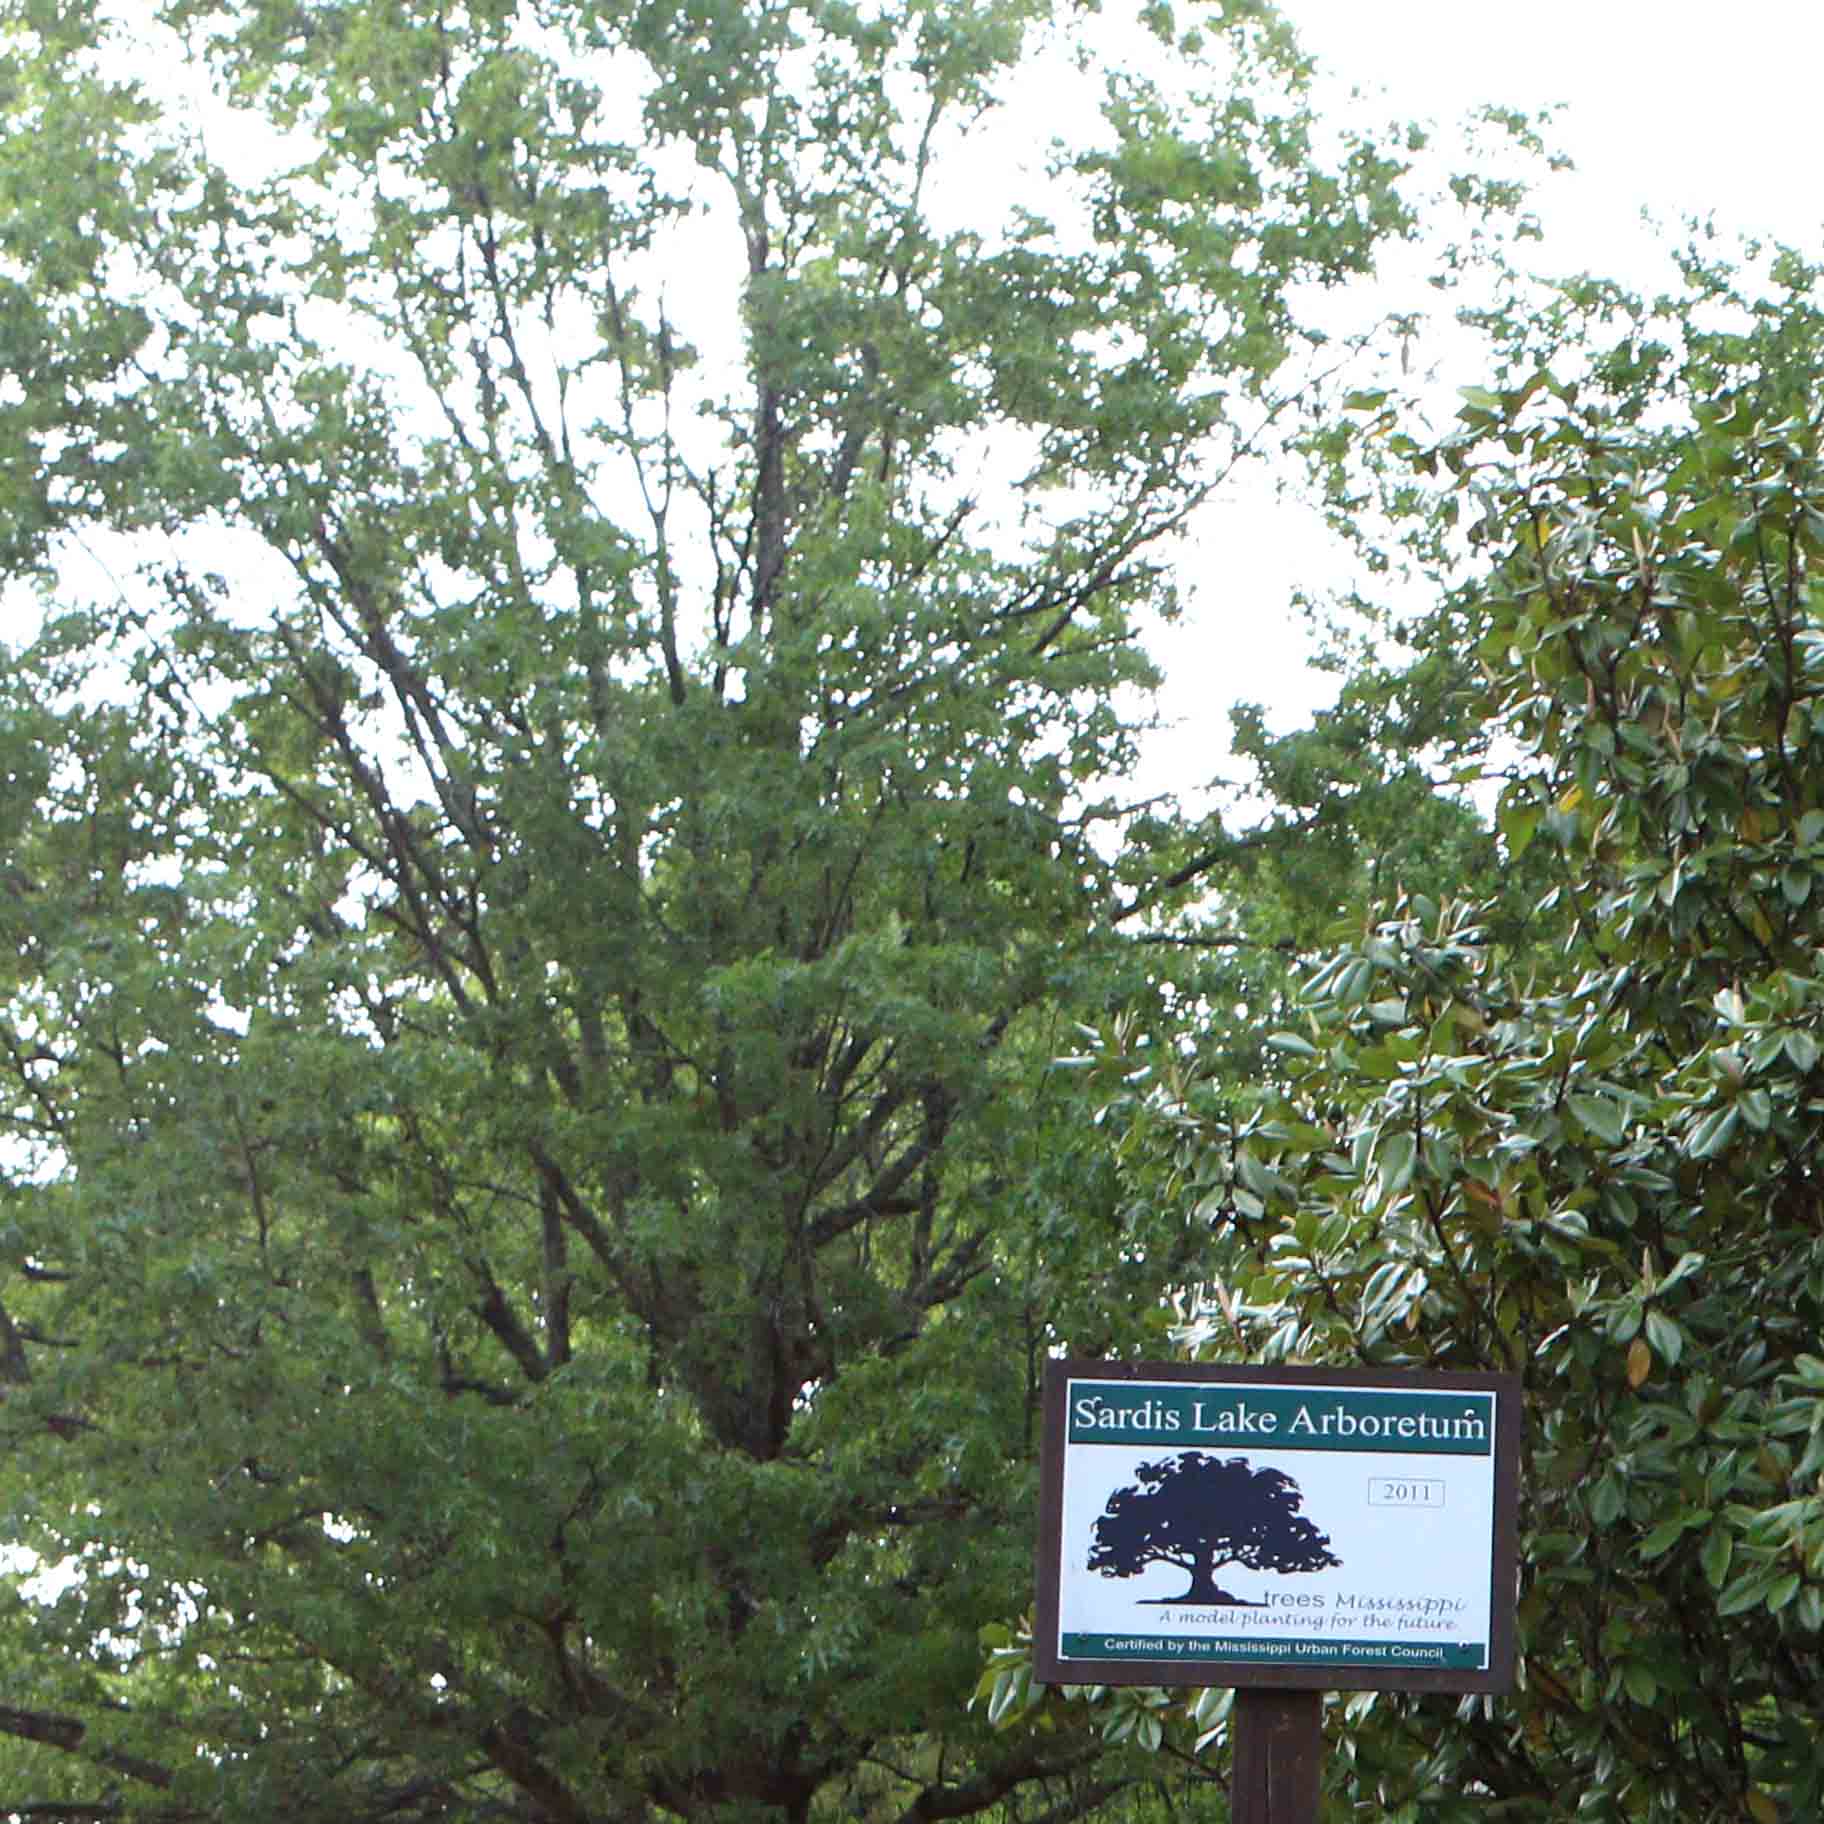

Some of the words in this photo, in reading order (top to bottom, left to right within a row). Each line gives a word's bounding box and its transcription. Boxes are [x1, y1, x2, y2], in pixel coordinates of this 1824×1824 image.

[1074, 1396, 1181, 1431] Sardis
[1192, 1401, 1278, 1435] Lake
[1287, 1405, 1486, 1441] Arboretum
[1382, 1482, 1432, 1502] 2011
[1336, 1591, 1466, 1616] Mississippi
[1160, 1610, 1172, 1624] A
[1178, 1608, 1236, 1626] model
[1240, 1609, 1325, 1632] planting
[1330, 1612, 1360, 1632] for
[1361, 1612, 1393, 1630] the
[1104, 1638, 1164, 1651] Certified
[1167, 1638, 1185, 1655] by
[1187, 1639, 1212, 1653] the
[1215, 1640, 1291, 1657] Mississippi
[1294, 1642, 1340, 1656] Urban
[1343, 1644, 1387, 1657] Forest
[1392, 1645, 1443, 1659] Council
